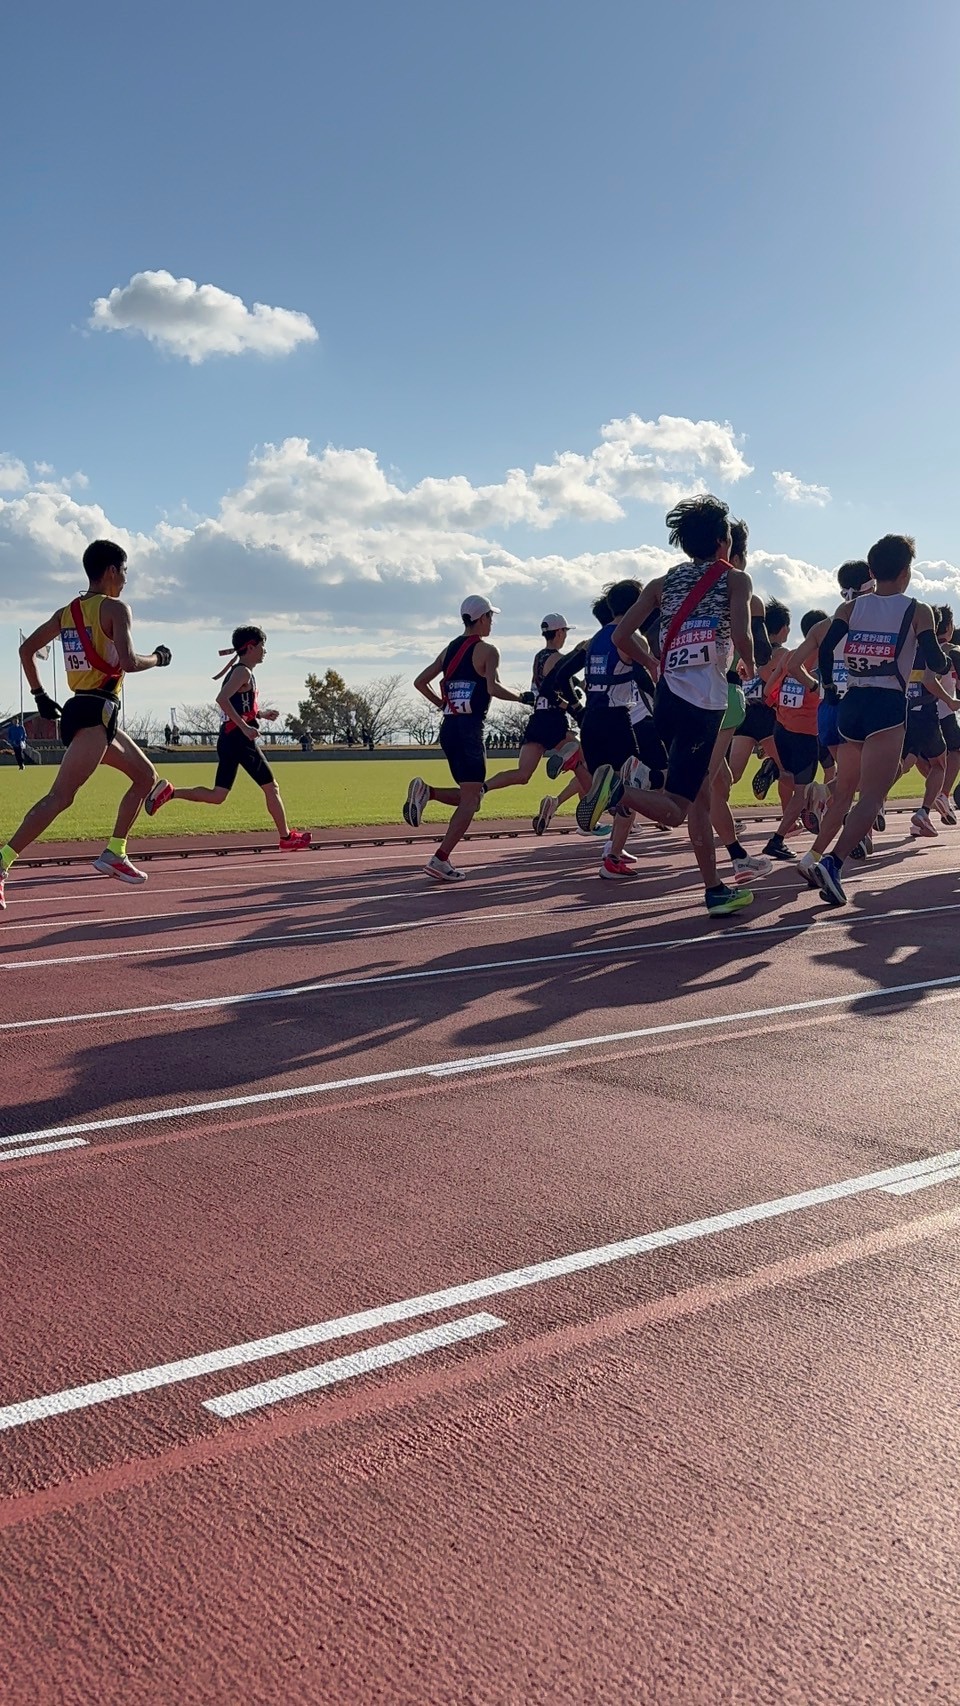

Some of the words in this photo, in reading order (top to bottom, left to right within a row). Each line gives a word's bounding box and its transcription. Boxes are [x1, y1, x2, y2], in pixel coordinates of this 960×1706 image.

[848, 644, 891, 655] 九州大学B
[668, 645, 710, 668] 52-1
[782, 694, 797, 707] 8-1
